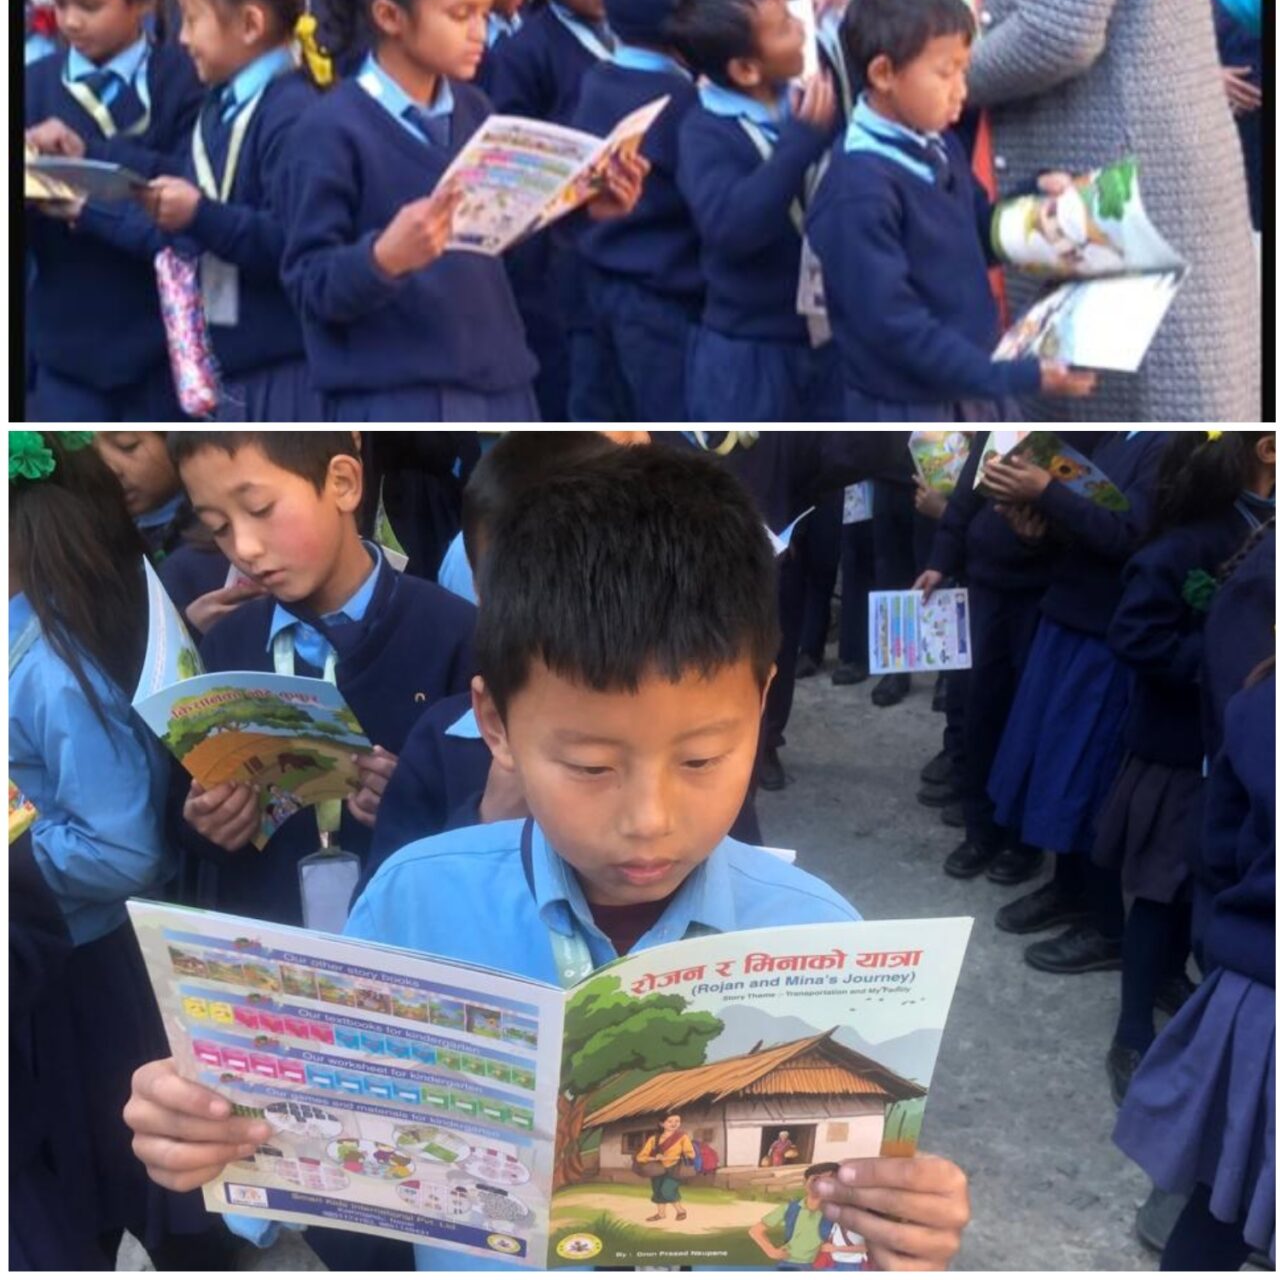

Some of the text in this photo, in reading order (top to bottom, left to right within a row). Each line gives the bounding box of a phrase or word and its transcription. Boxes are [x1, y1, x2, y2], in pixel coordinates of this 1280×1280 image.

[631, 949, 923, 995] रोजन र मिनाको यात्रा
[691, 971, 916, 998] (Rojan and Mina's Journey)
